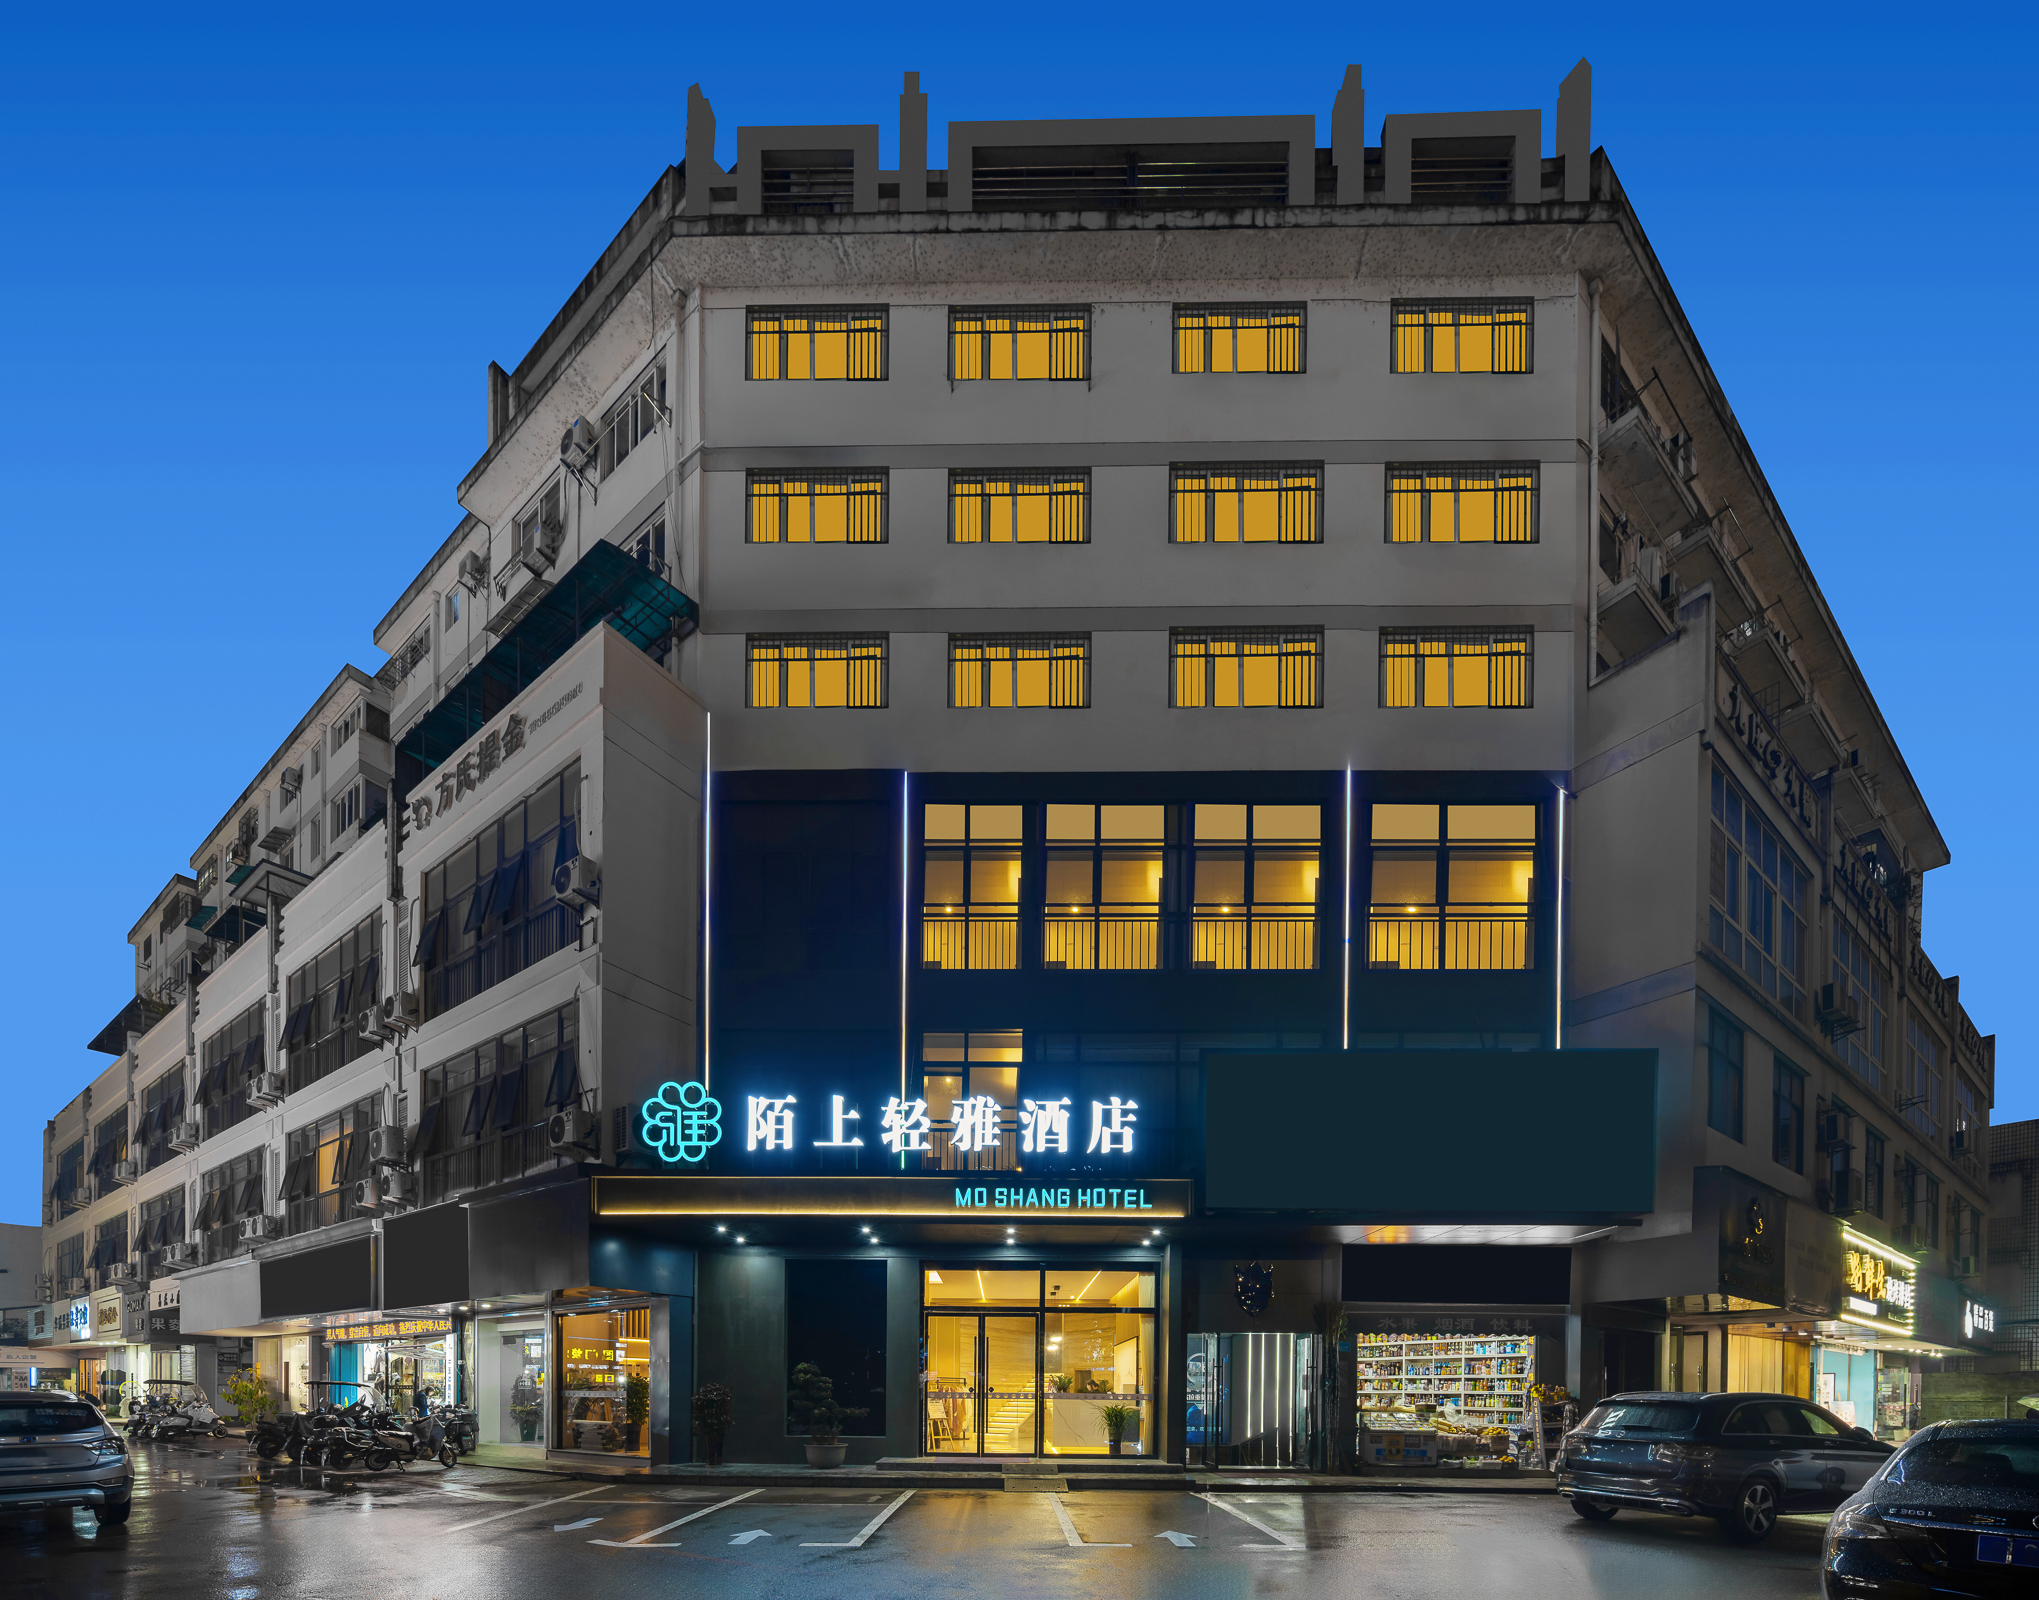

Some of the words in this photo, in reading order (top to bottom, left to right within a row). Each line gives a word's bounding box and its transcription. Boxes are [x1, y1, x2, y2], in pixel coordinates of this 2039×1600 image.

[747, 1094, 1139, 1154] 陌上轻雅酒店
[954, 1187, 987, 1208] MO
[994, 1187, 1070, 1209] SHANG
[1077, 1187, 1153, 1209] HOTEL
[1377, 1317, 1418, 1331] 水果
[1433, 1317, 1475, 1331] 烟酒
[1489, 1318, 1532, 1332] 饮料
